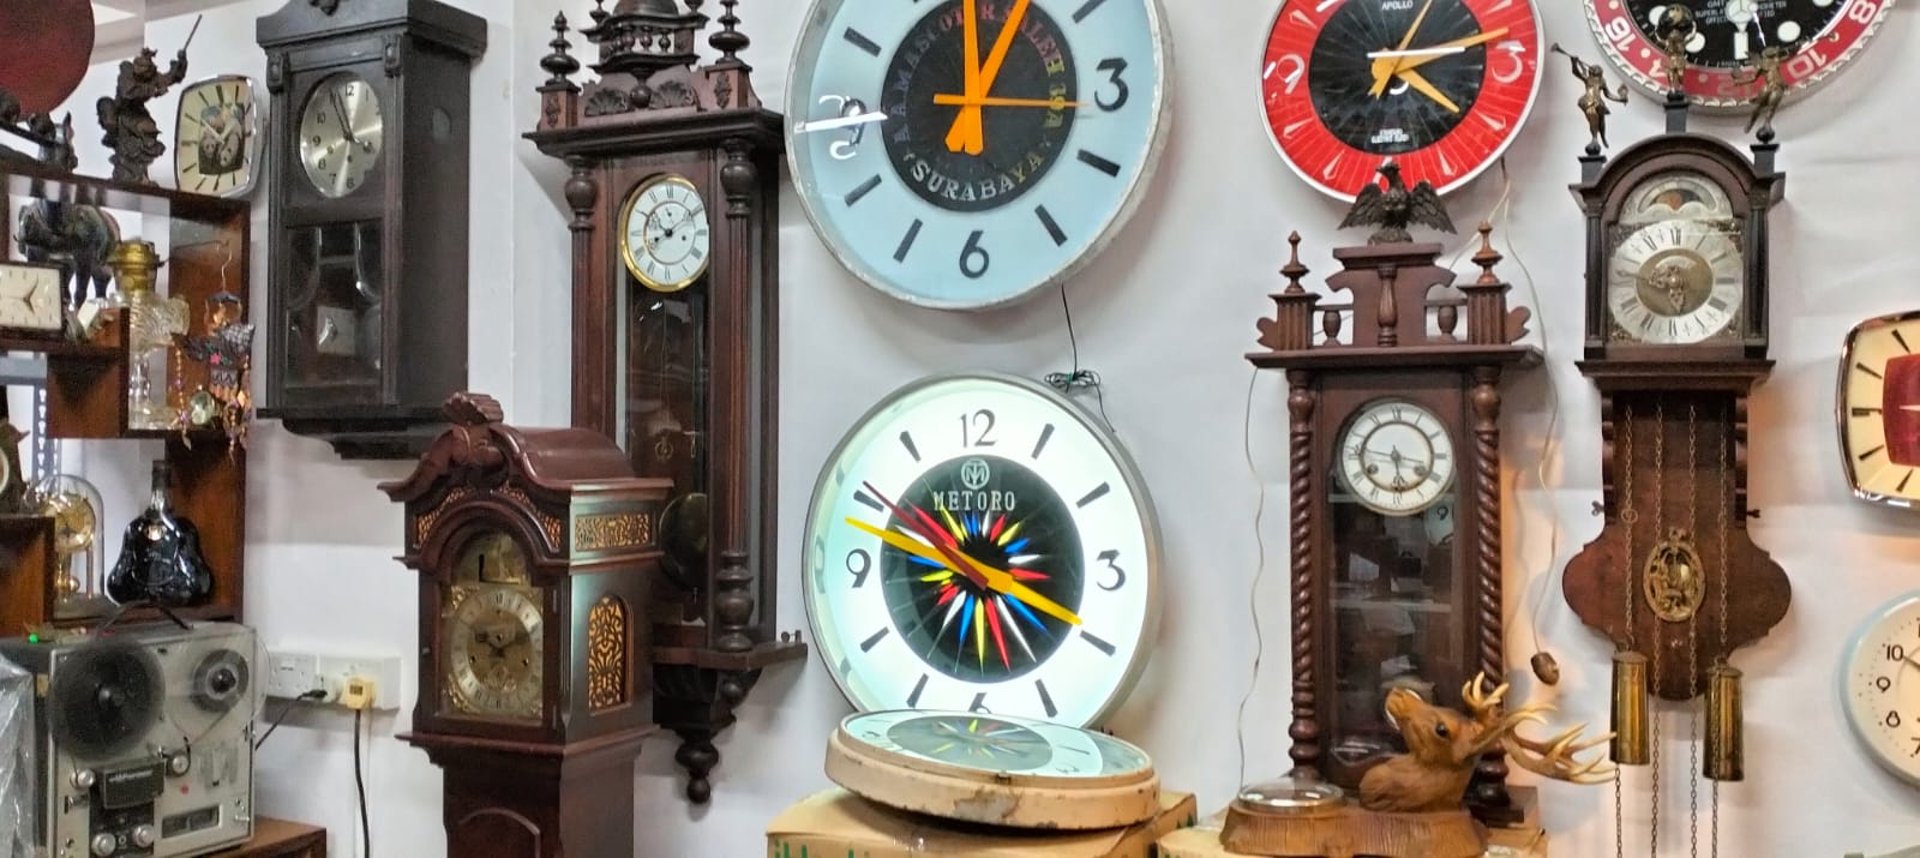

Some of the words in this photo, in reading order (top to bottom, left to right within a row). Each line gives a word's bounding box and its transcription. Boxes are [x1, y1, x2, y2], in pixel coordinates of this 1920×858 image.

[1382, 1, 1414, 11] APOLLO
[1605, 16, 1637, 52] 16
[1277, 54, 1305, 95] 9
[1491, 40, 1524, 83] 3
[1787, 48, 1827, 79] 10
[1094, 57, 1129, 112] 3
[312, 135, 321, 147] 9
[910, 154, 1046, 201] SURABAYA
[959, 230, 990, 279] 6
[960, 408, 996, 448] 12
[933, 490, 1015, 511] METORO
[846, 548, 872, 589] 9
[1096, 549, 1126, 591] 3
[1886, 644, 1904, 661] 10
[1876, 676, 1891, 693] 9
[1885, 710, 1901, 728] 8
